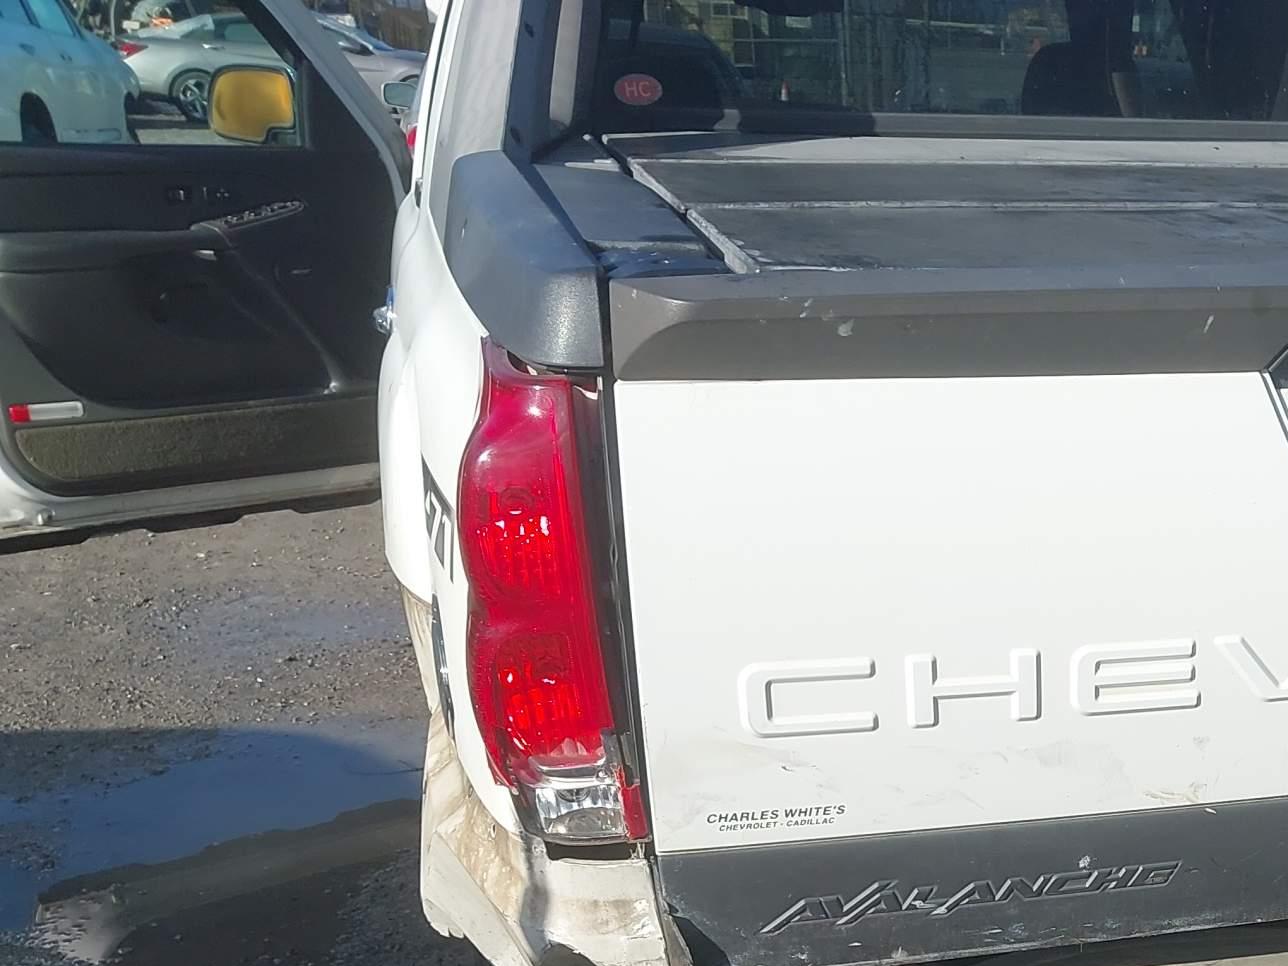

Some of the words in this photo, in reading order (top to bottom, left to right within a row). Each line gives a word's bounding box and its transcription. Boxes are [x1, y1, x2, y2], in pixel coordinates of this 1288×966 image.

[624, 81, 652, 97] HC
[706, 809, 779, 824] CHARLES
[784, 805, 846, 819] WHITE'S
[719, 821, 778, 832] CHEVROLET
[786, 817, 835, 827] CADILLAC
[758, 860, 1182, 934] AVALANCHE
